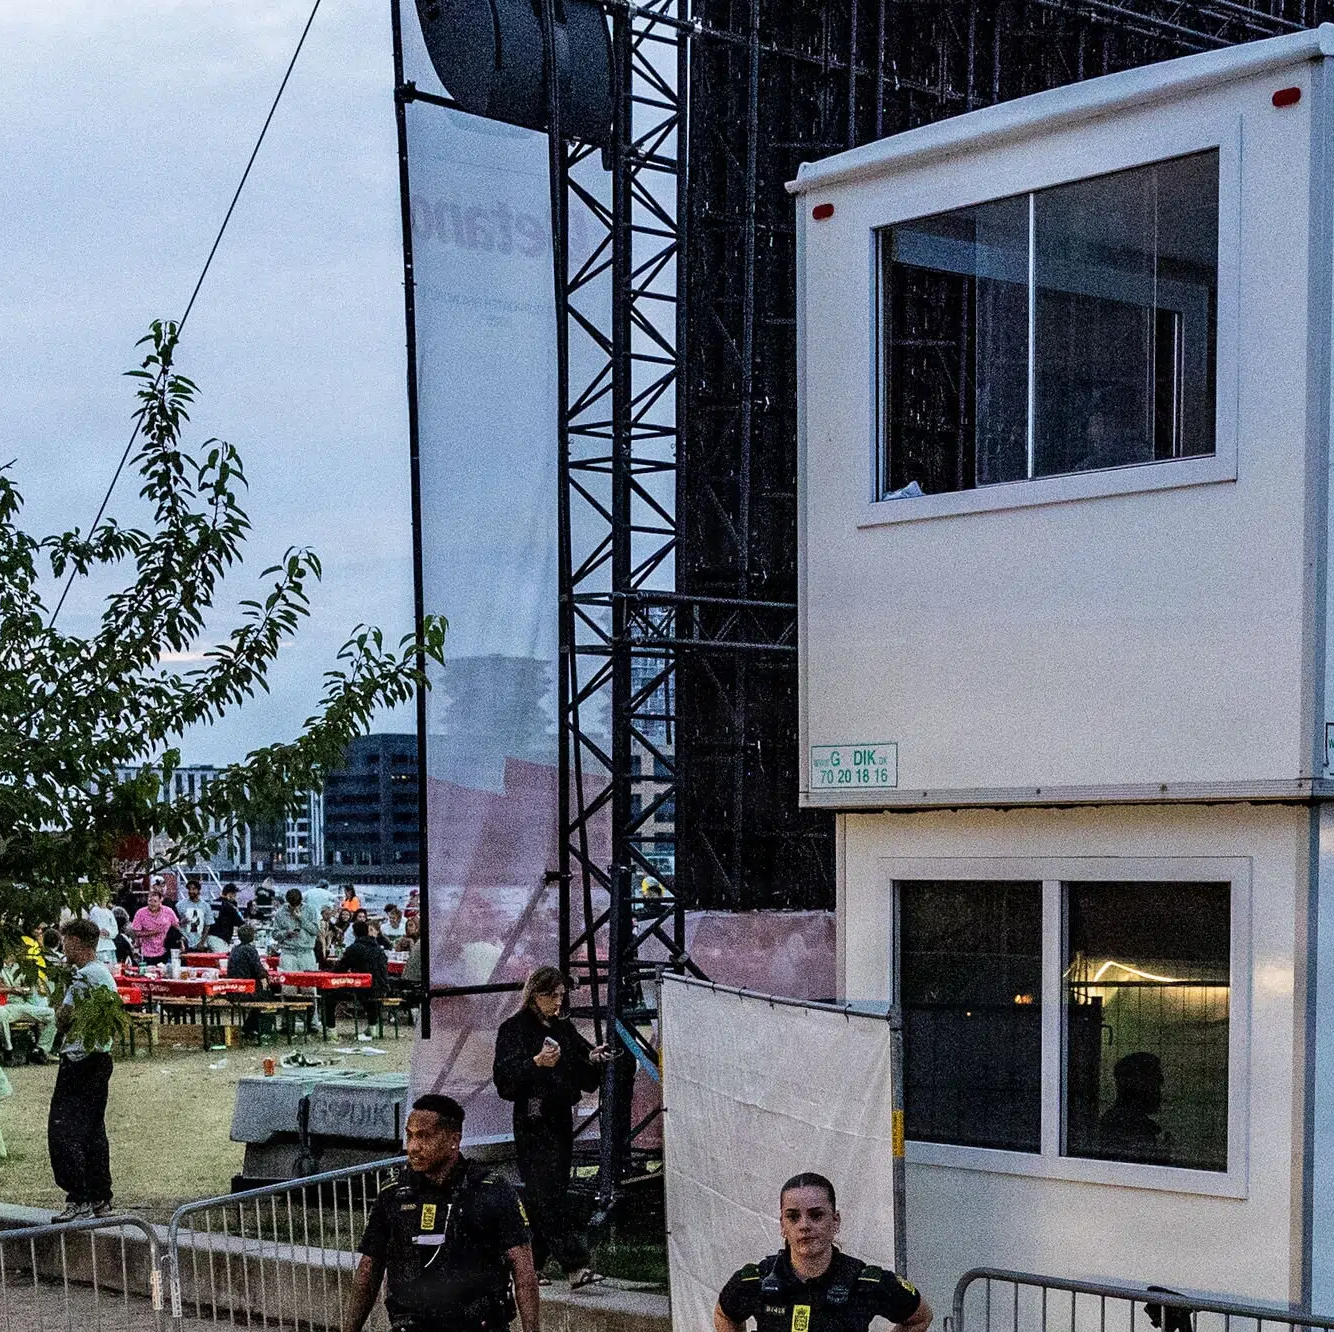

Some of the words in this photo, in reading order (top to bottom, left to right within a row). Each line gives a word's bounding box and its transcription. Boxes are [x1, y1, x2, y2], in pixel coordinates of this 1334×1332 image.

[820, 770, 834, 784] 70
[838, 769, 852, 783] 20
[856, 768, 870, 783] 18
[875, 767, 888, 782] 16
